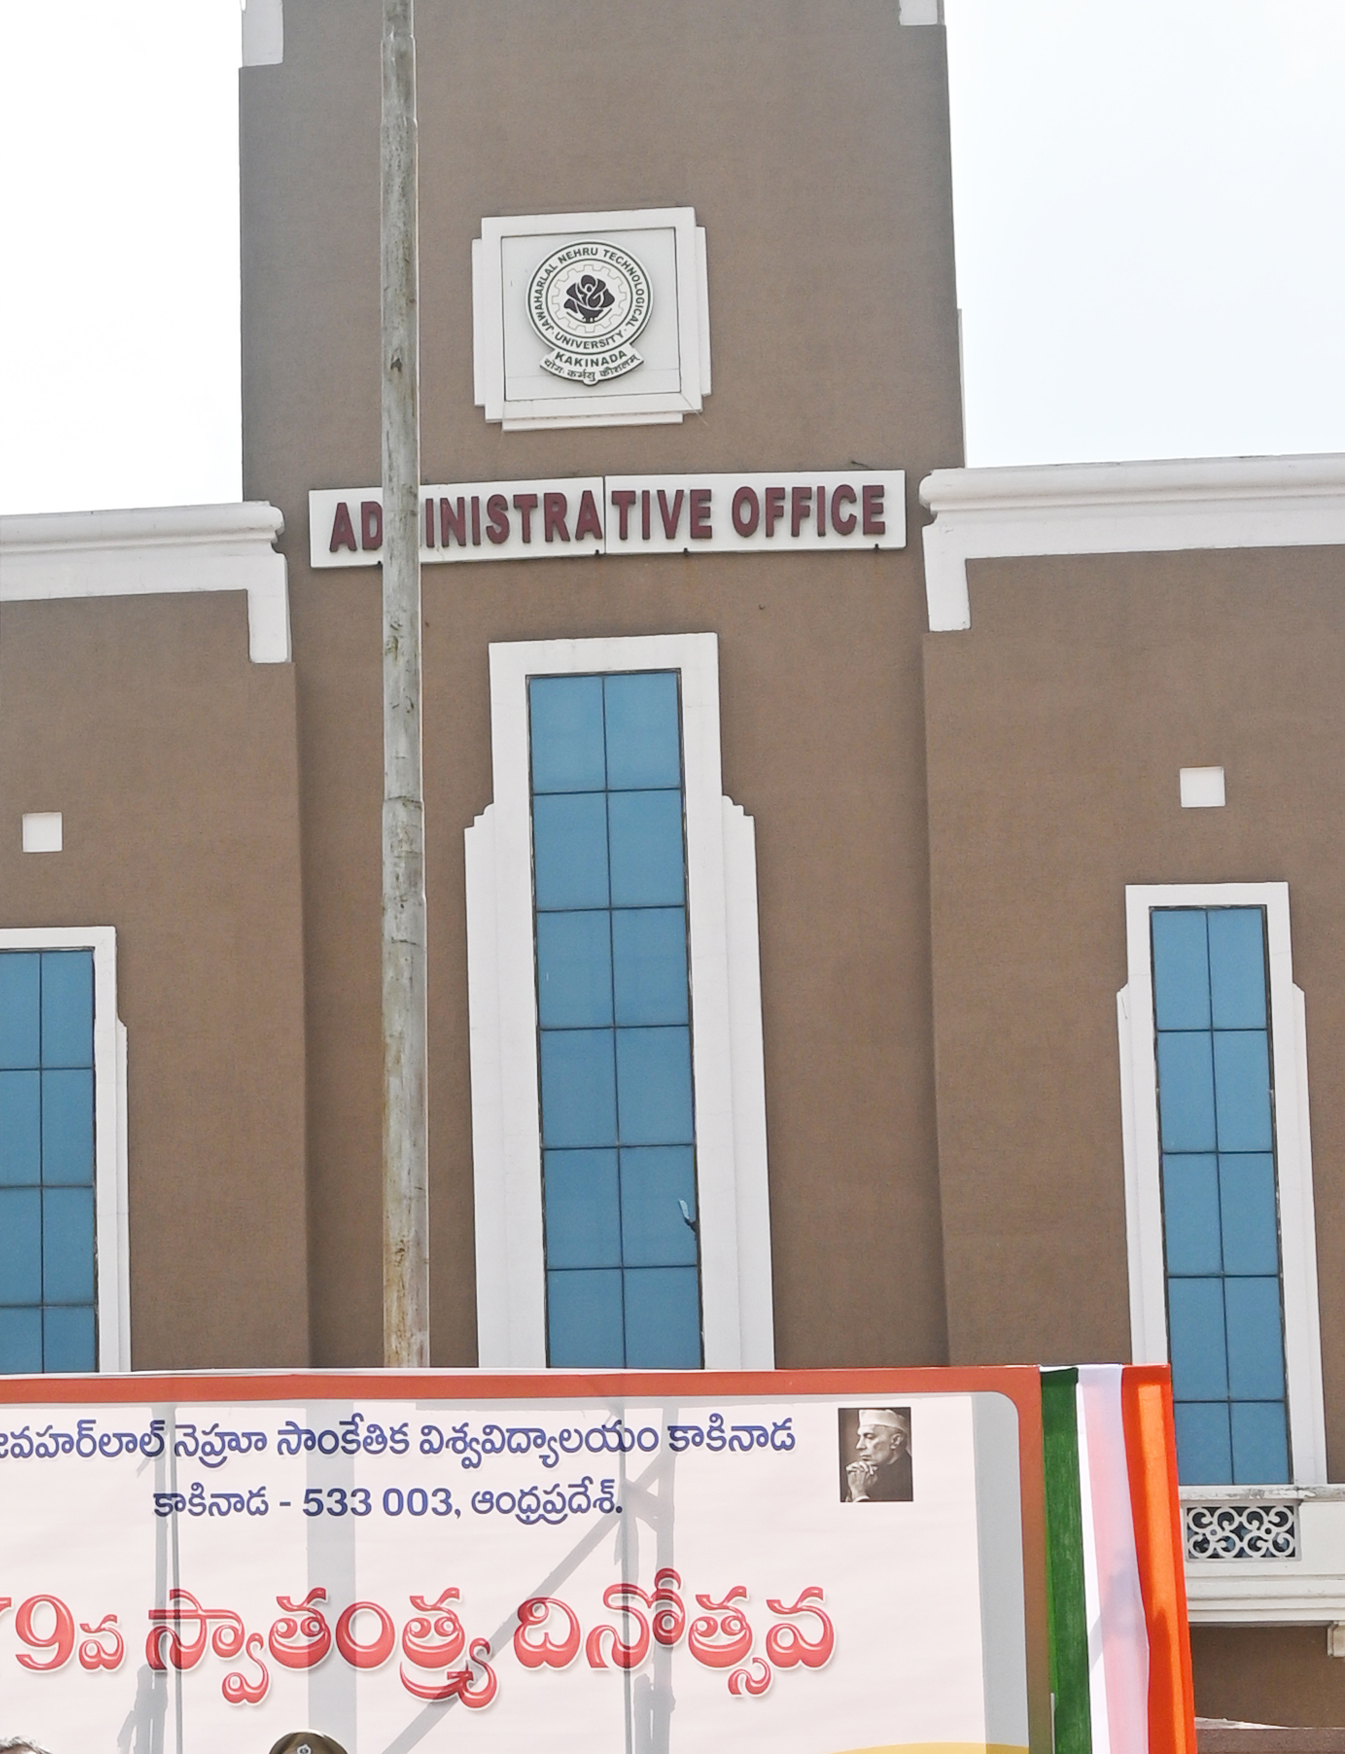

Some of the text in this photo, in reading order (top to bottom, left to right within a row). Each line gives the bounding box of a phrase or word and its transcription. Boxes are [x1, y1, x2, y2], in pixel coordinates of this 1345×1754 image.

[533, 247, 645, 332] JAWAHARLAL NEHRU TECHNOLOGICAL
[554, 329, 625, 350] UNIVERSITY
[554, 349, 628, 368] KAKINADA
[329, 483, 886, 553] ADINISTRATIVE OFFICE
[276, 1412, 410, 1456] సాంకేతిక
[419, 1418, 660, 1470] విశ్వవిద్యాలయం
[667, 1412, 796, 1453] కాకినాడ
[152, 1481, 270, 1518] కాకినాడ
[303, 1487, 373, 1517] 533
[382, 1486, 461, 1519] 003,
